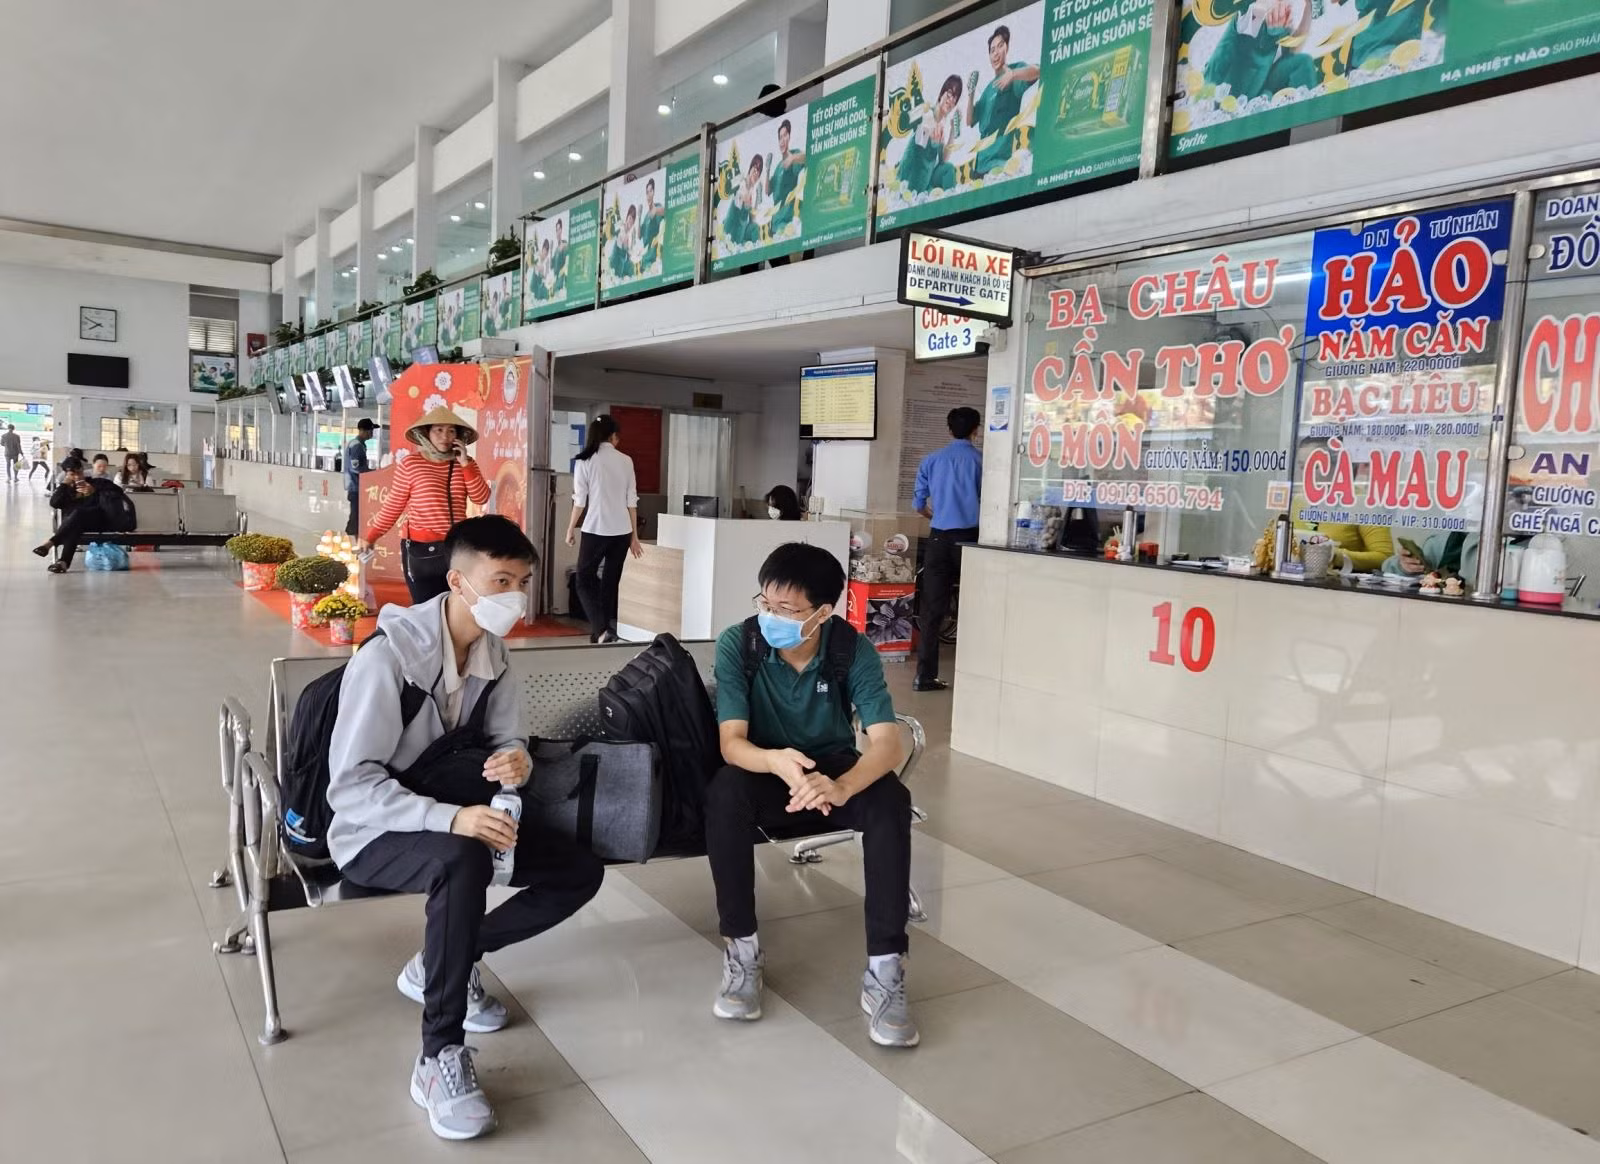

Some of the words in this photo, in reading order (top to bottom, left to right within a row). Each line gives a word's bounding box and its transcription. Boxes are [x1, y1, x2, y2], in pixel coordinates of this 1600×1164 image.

[1514, 47, 1550, 64] NÀO
[1552, 41, 1573, 54] SAO
[849, 108, 867, 124] COOL
[1177, 132, 1207, 152] Sprite
[1453, 209, 1499, 235] NHÂN
[911, 238, 944, 266] LỐI
[952, 249, 978, 272] RA
[985, 255, 1010, 277] XE
[1319, 215, 1492, 320] HẢO
[927, 267, 939, 279] CHO
[909, 277, 976, 297] DEPARTURE
[980, 287, 1007, 302] GATE
[1046, 283, 1107, 330] BA
[1128, 252, 1279, 320] CHÂU
[928, 332, 958, 351] Gate
[963, 327, 971, 346] 3
[1317, 319, 1398, 363] NĂM
[1403, 308, 1490, 356] CĂN
[1033, 326, 1144, 402] CẦN
[1155, 324, 1295, 399] THƠ
[1522, 312, 1600, 433] CH
[1311, 384, 1381, 424] BẠC
[1389, 371, 1480, 415] LIÊU
[1028, 410, 1051, 468] Ô
[1058, 408, 1146, 470] MÔN
[1303, 438, 1356, 508] CÀ
[1365, 448, 1469, 510] MAU
[1529, 451, 1590, 476] AN
[1096, 481, 1223, 511] 0913.650.794
[1533, 484, 1596, 507] GIƯỜNG
[1510, 507, 1545, 532] GHẾ
[1587, 517, 1600, 536] C
[1150, 601, 1215, 672] 10
